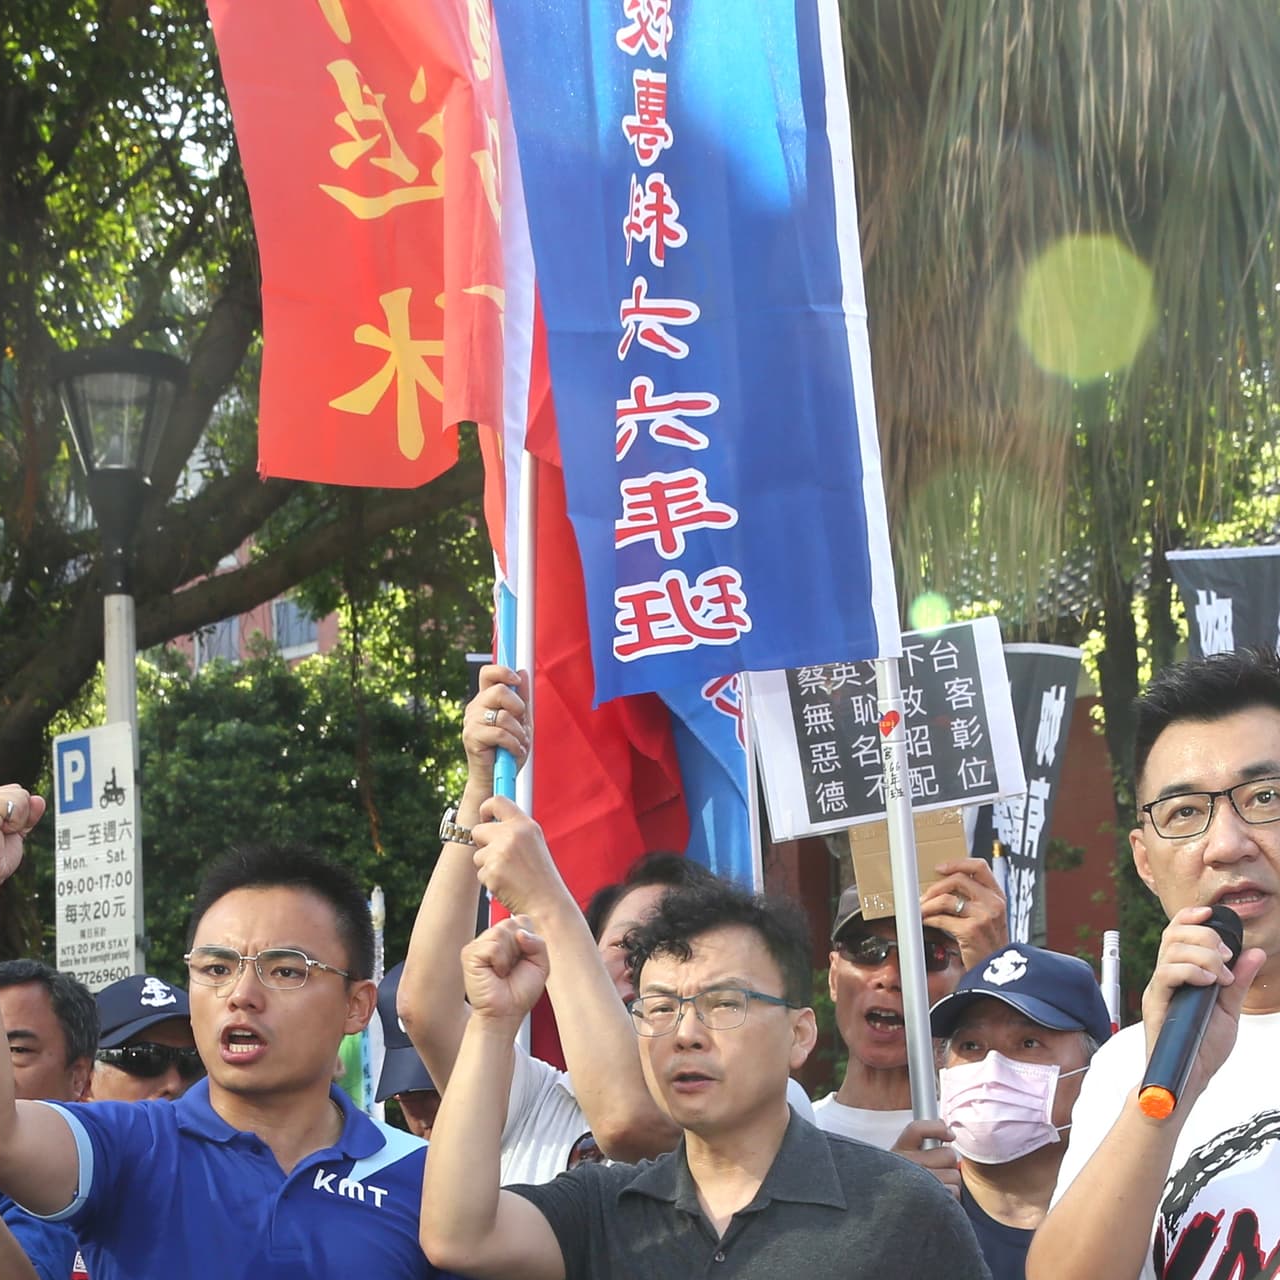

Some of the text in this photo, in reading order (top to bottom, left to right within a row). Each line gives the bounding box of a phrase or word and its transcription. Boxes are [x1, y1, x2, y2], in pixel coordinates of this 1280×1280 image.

[63, 750, 86, 802] P
[58, 819, 133, 850] 週一至週六
[65, 895, 126, 923] 每次20元
[108, 938, 129, 950] STAY
[312, 1168, 389, 1209] KMT
